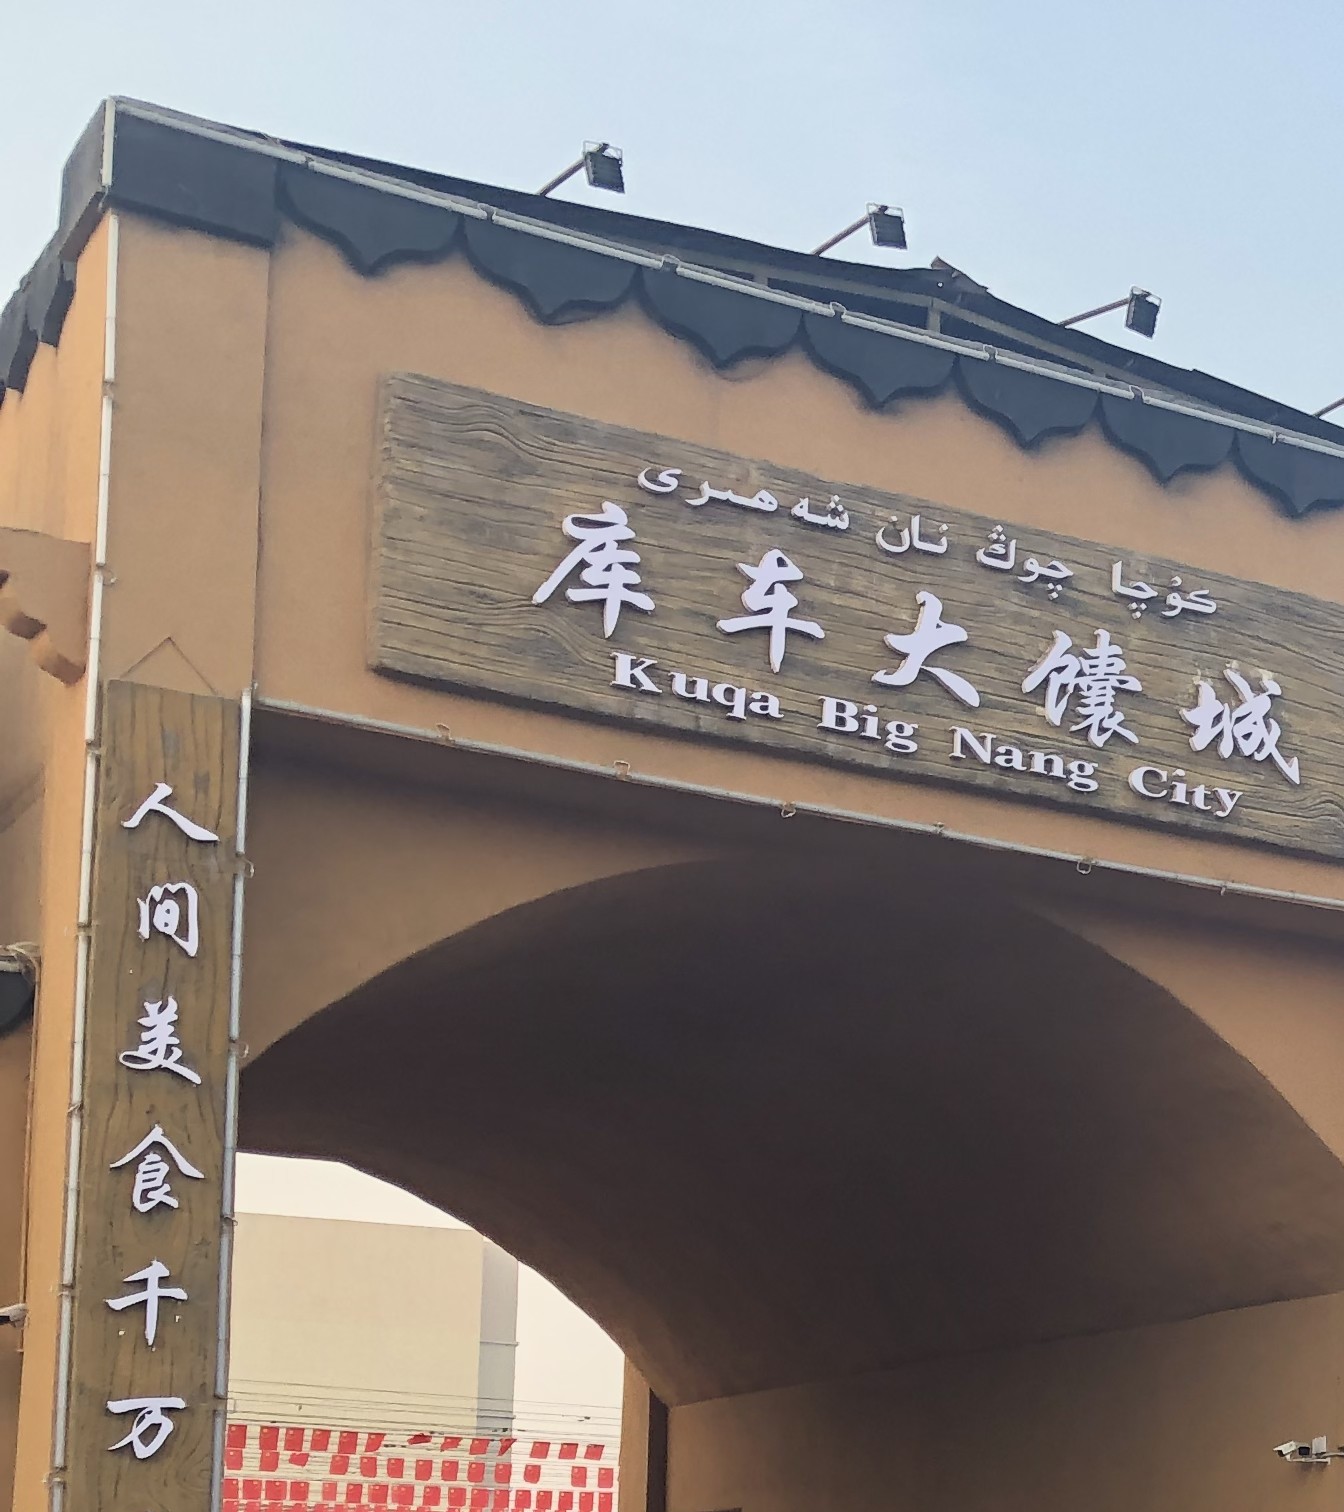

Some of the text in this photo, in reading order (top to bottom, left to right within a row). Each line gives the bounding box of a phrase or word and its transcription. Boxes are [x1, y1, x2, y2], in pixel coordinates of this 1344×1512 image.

[531, 501, 1301, 785] 库车大馕城
[609, 651, 1244, 817] Kuqa Big Nang City
